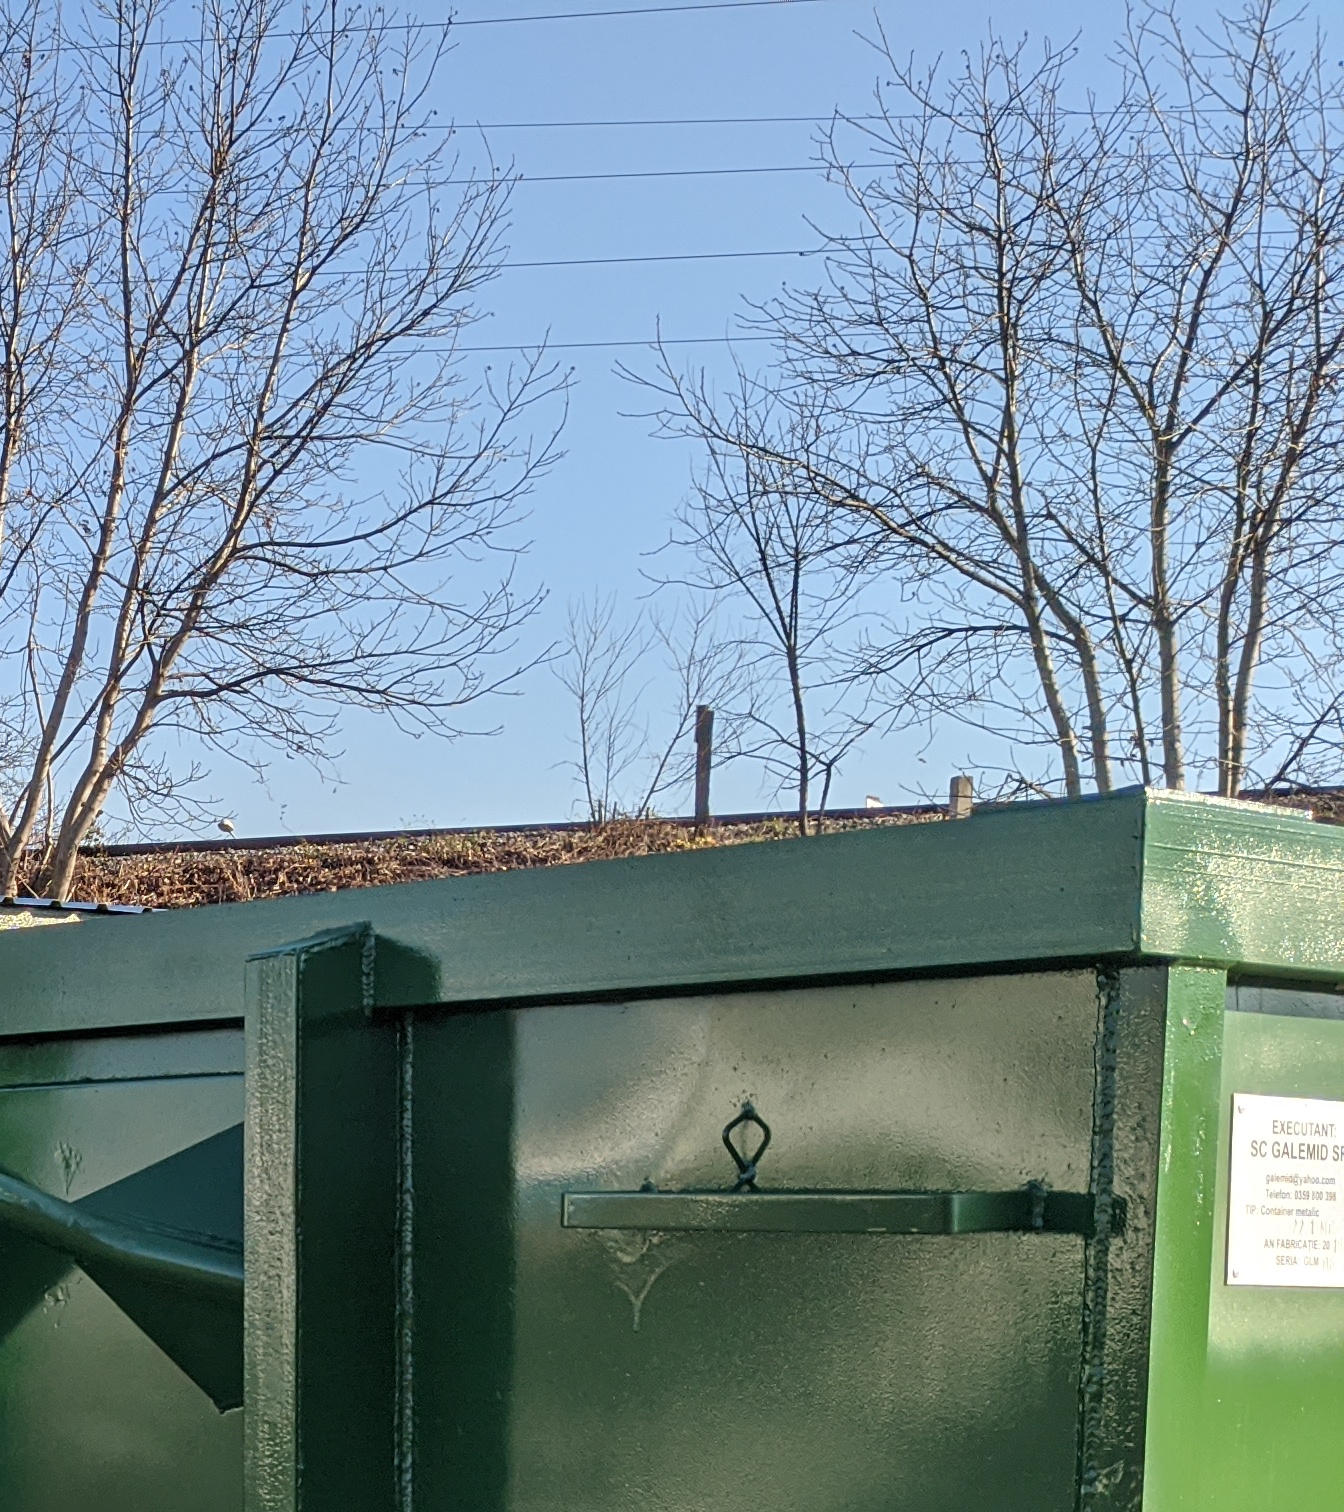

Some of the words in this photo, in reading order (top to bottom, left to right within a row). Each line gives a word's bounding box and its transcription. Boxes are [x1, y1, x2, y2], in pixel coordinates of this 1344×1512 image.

[1272, 1119, 1337, 1138] EXECUTANT:
[1250, 1139, 1268, 1158] SC
[1271, 1140, 1328, 1161] GALEMID
[1266, 1188, 1292, 1200] Telefon:
[1260, 1205, 1294, 1216] Container
[1263, 1238, 1274, 1249] AN
